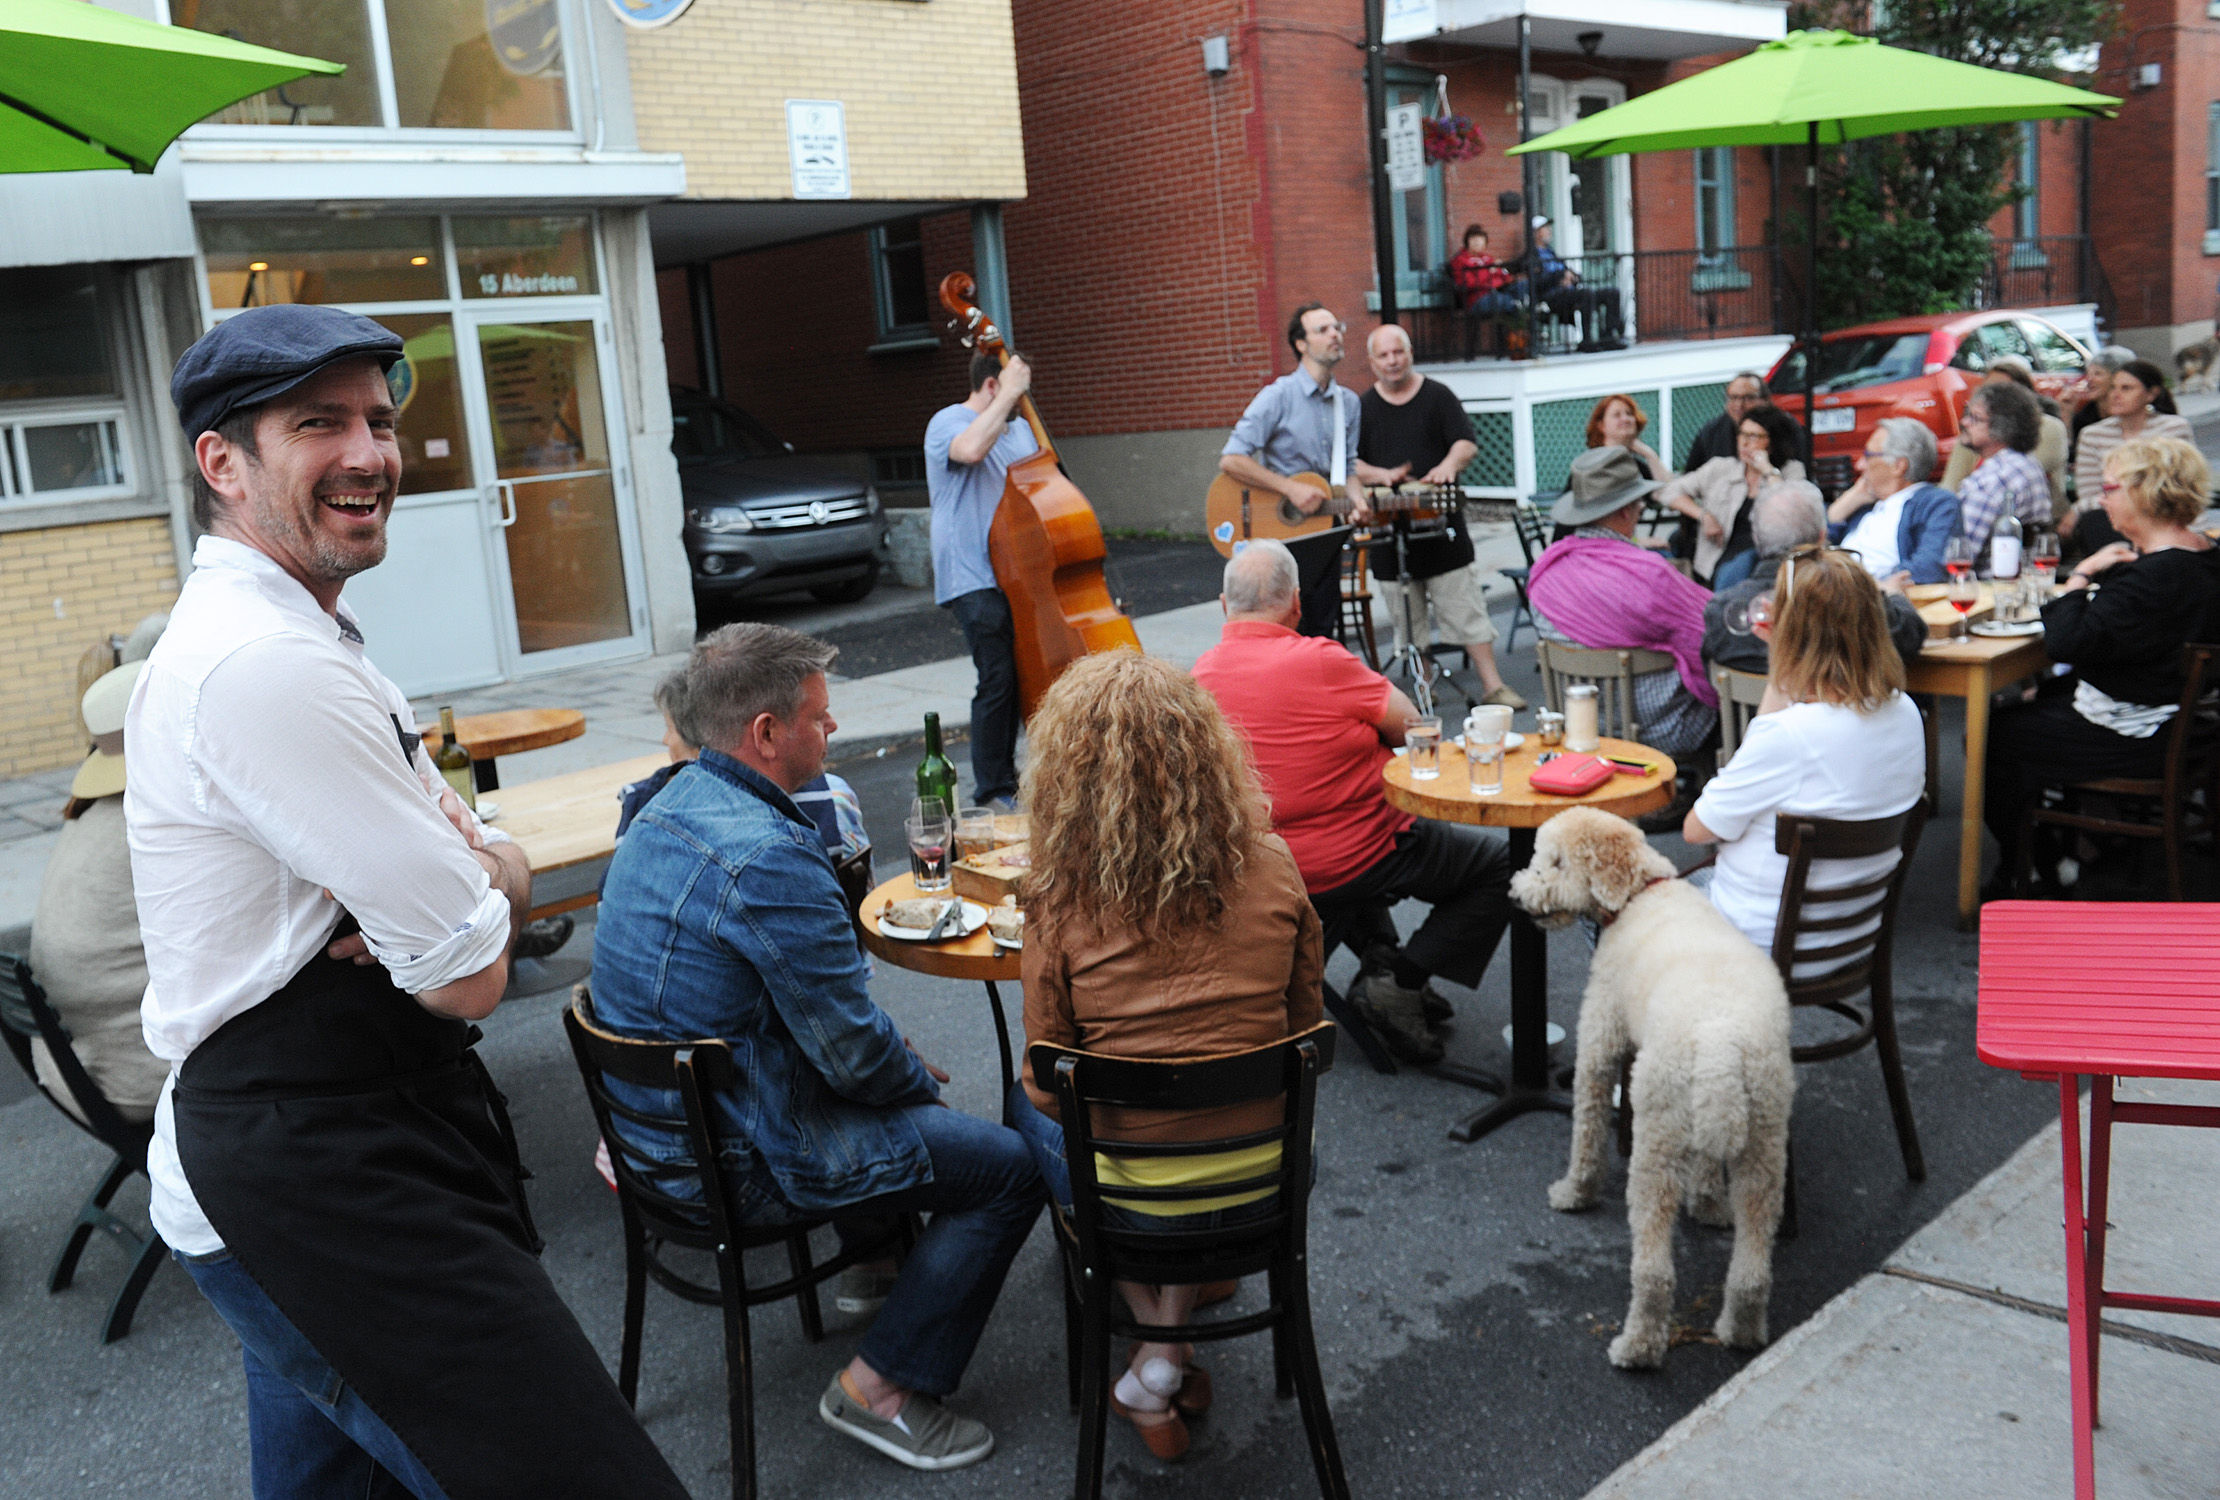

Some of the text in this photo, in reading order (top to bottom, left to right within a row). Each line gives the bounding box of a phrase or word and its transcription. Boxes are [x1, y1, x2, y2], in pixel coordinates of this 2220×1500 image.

[1400, 112, 1410, 128] P
[479, 272, 578, 294] 15 Aberdeen
